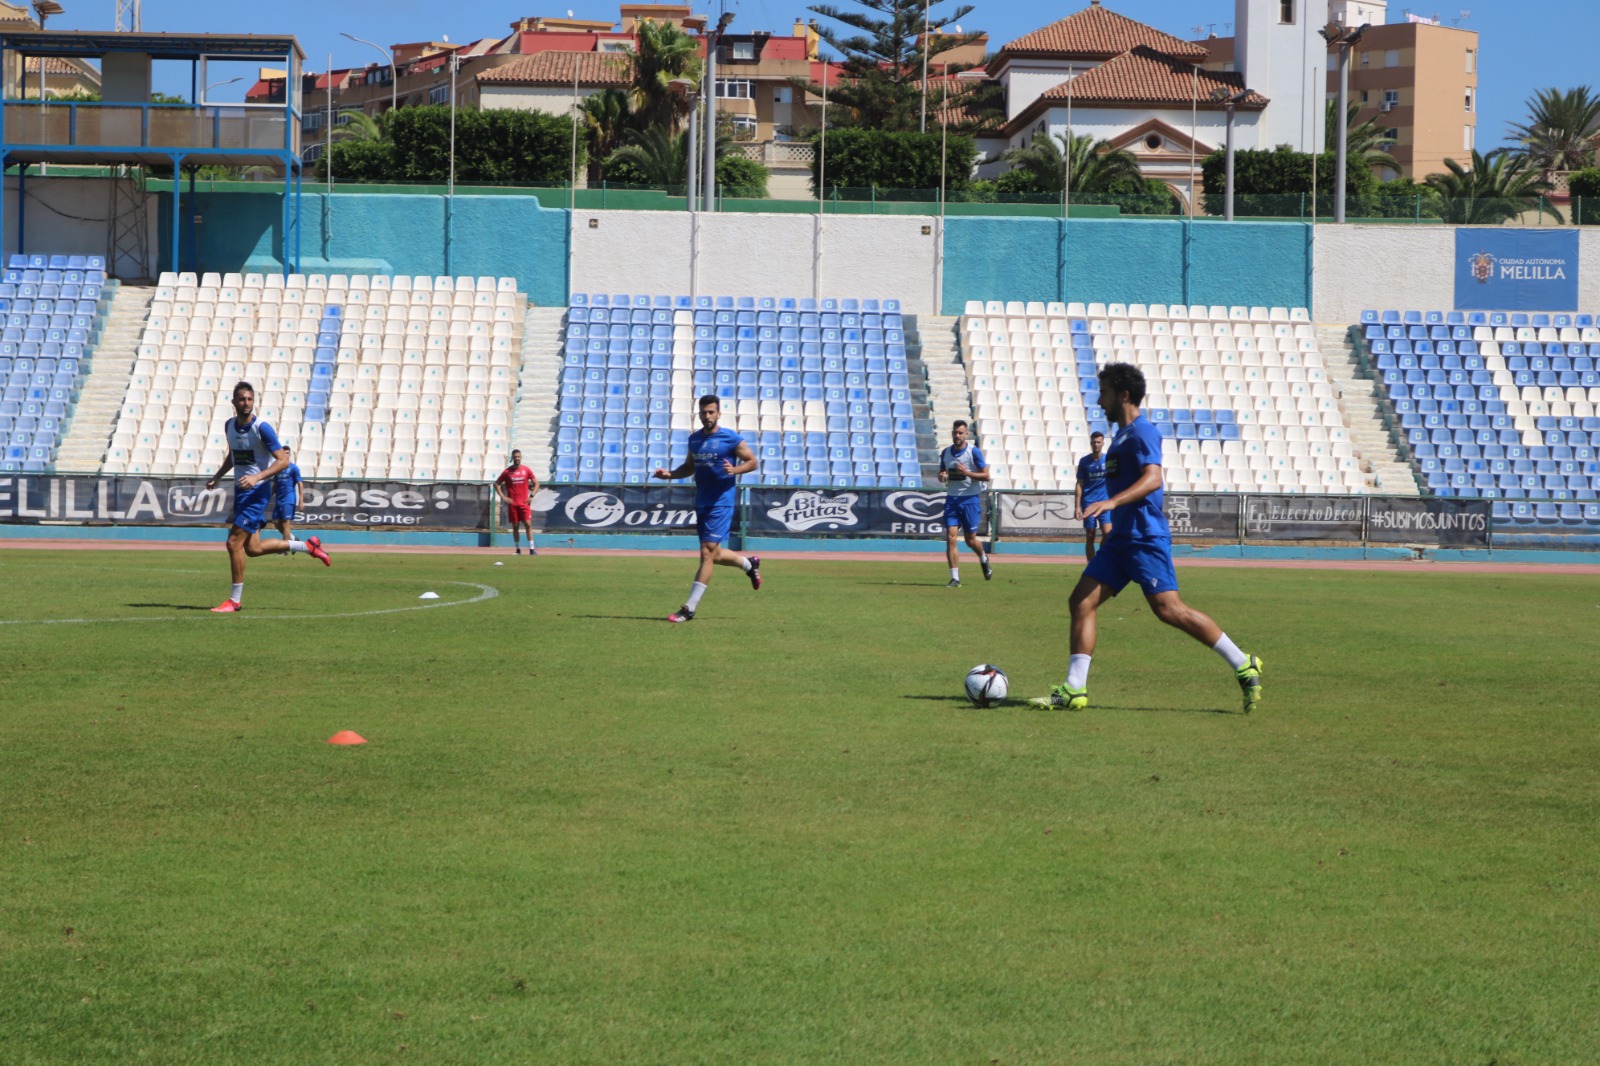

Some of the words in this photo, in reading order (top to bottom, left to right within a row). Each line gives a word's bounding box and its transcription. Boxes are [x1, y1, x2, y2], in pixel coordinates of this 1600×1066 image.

[1500, 266, 1566, 279] MELILLA
[565, 491, 698, 528] Coim
[795, 495, 816, 511] Bi
[293, 511, 346, 523] Sport
[353, 512, 423, 525] Center
[783, 504, 849, 523] frutas
[1371, 511, 1486, 531] #SUBIMOSJUNTOS
[891, 521, 946, 535] FRIG
